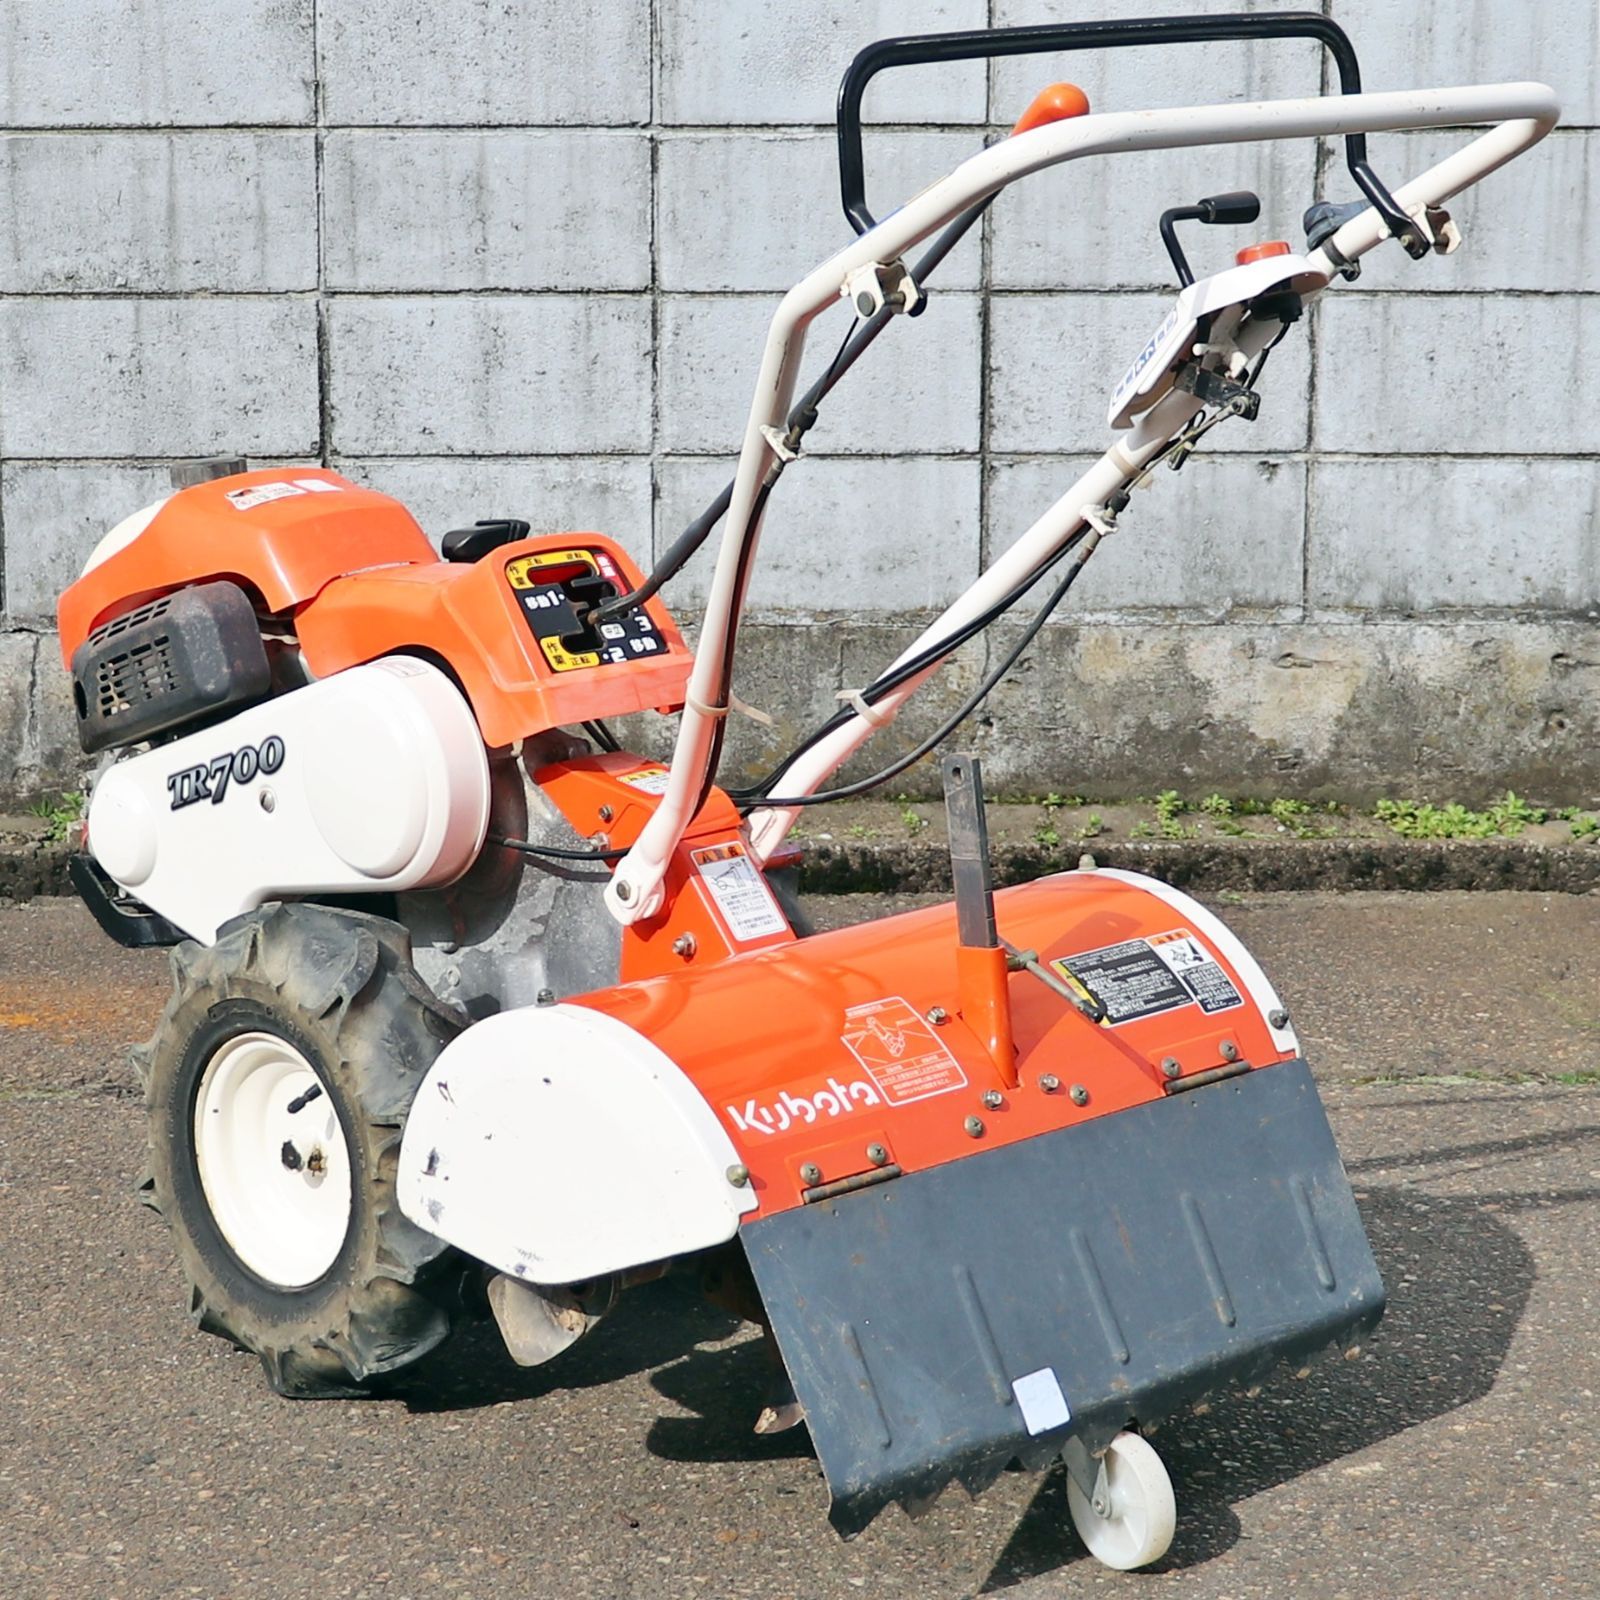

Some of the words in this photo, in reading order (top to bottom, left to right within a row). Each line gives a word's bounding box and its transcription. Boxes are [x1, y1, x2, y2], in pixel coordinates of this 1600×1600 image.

[634, 615, 653, 632] 3
[608, 646, 628, 664] 2
[167, 735, 285, 811] TR700
[726, 1077, 880, 1135] Kubota
